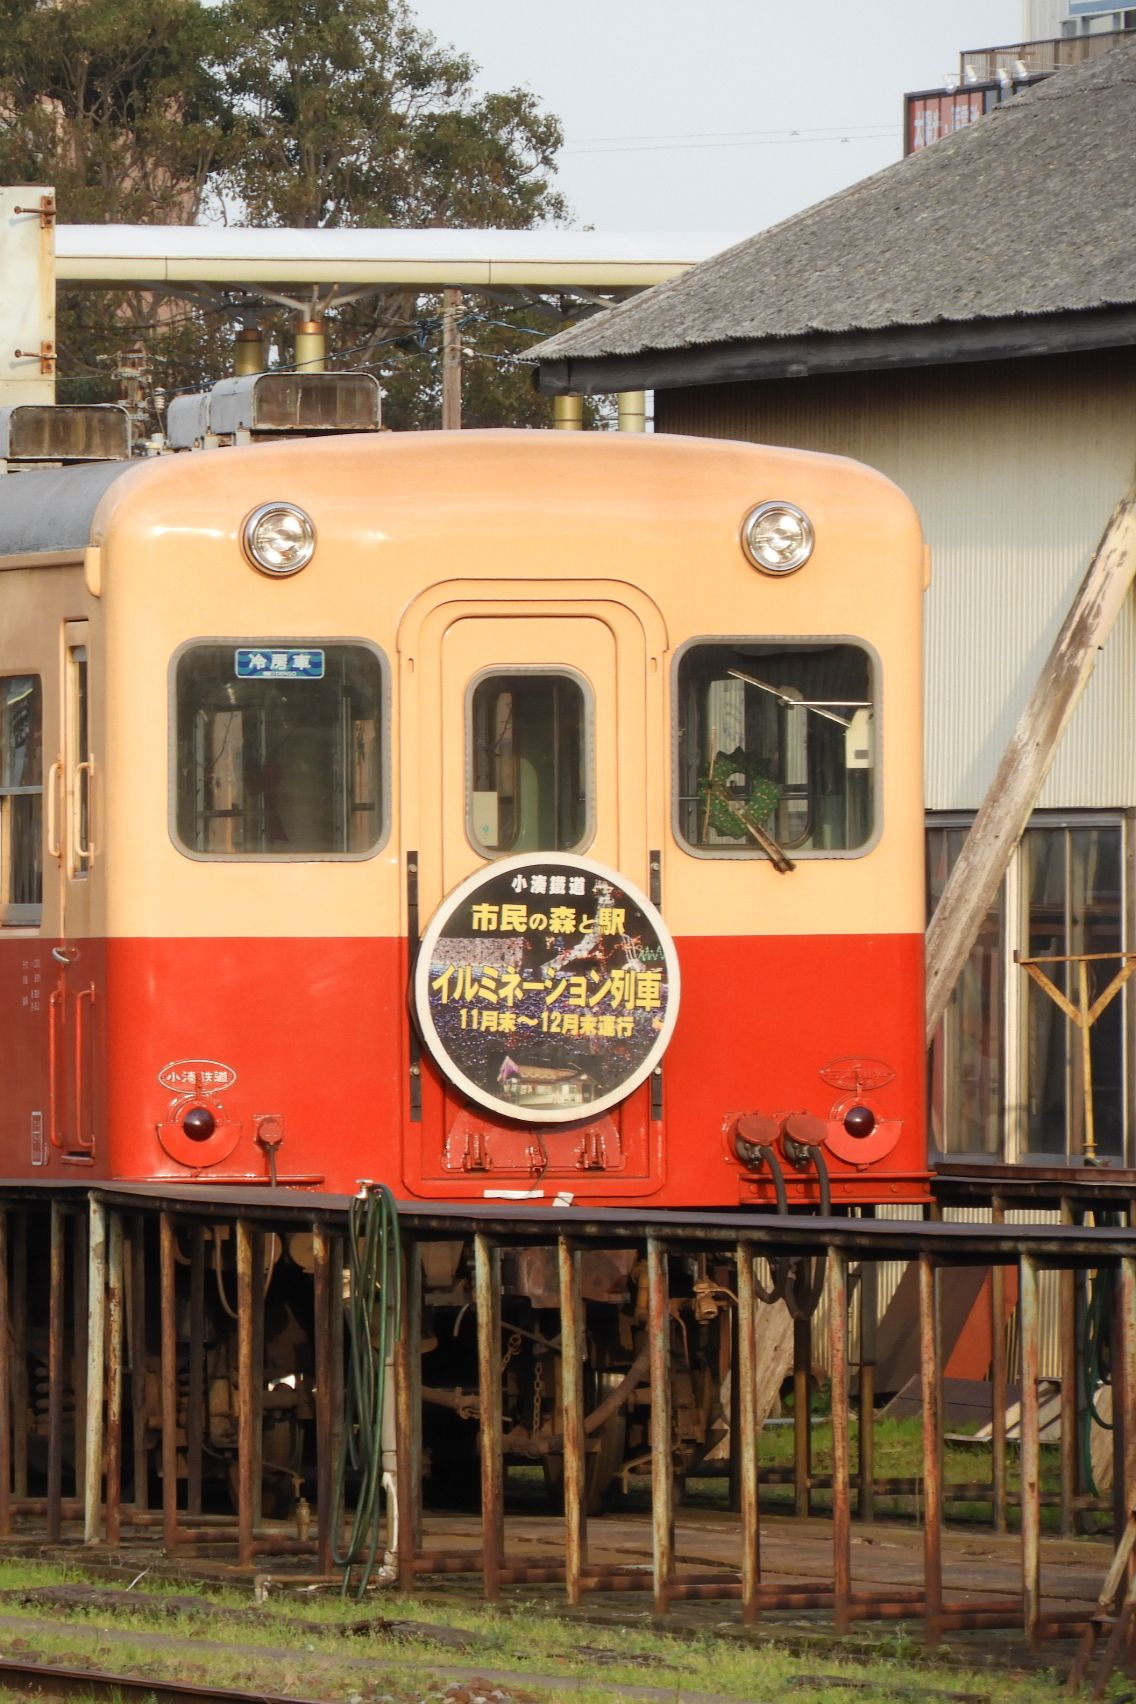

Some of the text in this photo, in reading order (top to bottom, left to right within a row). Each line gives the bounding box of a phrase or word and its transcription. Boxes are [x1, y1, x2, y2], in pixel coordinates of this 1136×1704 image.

[248, 653, 312, 671] 冷房車
[471, 902, 627, 936] 市民の森と駅
[431, 963, 663, 1012] イルミネーション列車
